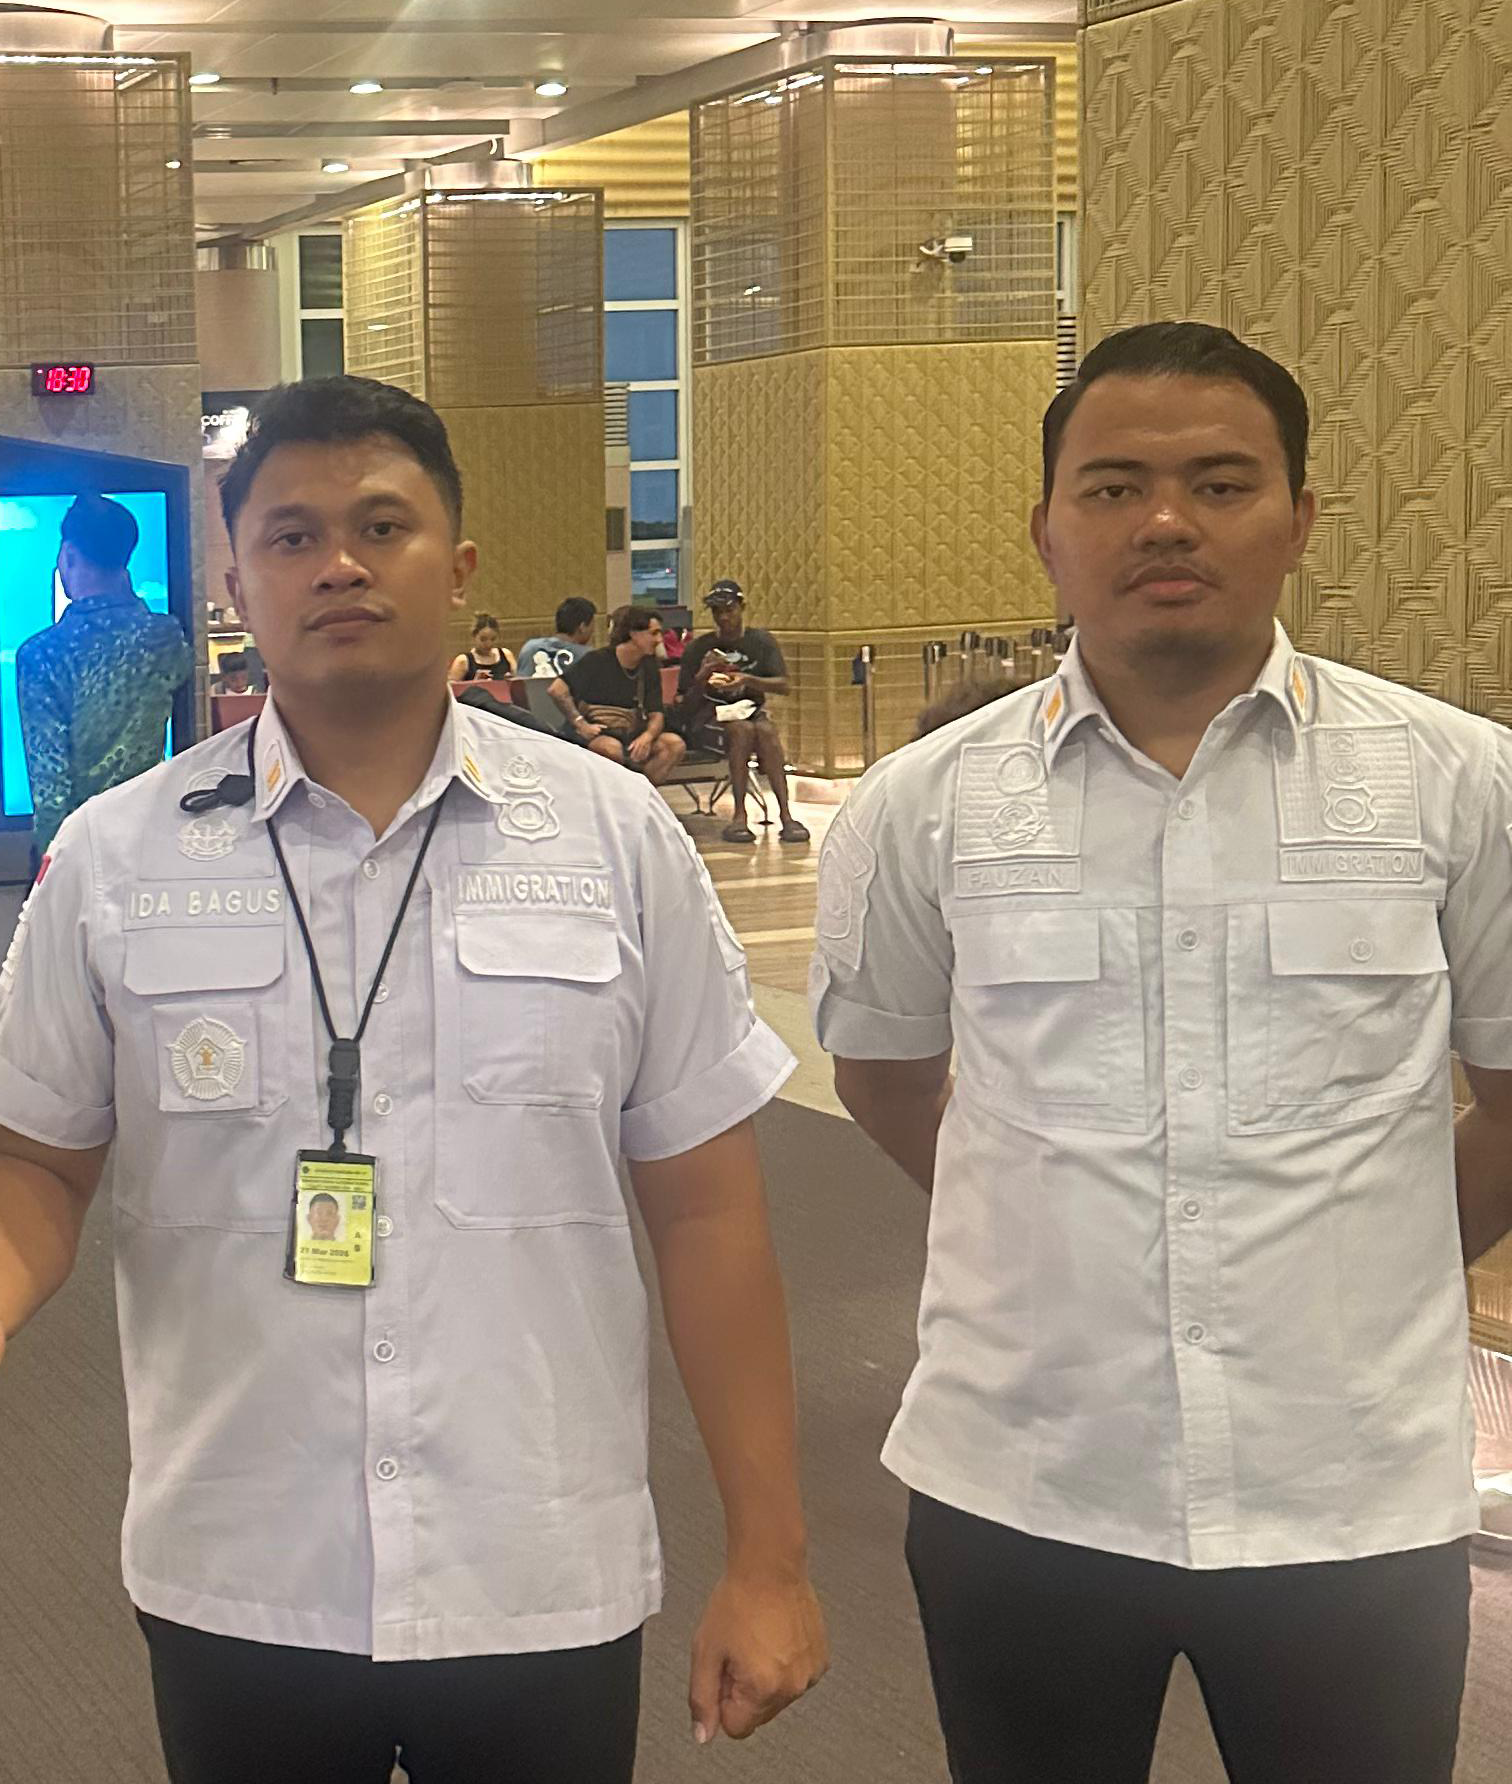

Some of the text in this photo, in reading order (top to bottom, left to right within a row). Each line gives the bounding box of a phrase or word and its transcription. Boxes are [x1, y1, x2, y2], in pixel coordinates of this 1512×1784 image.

[968, 865, 1065, 889] FAUZAN
[1287, 852, 1421, 874] IMMIGRATION
[129, 887, 282, 920] IDA BAGUS
[457, 873, 610, 907] IMMIGRATION
